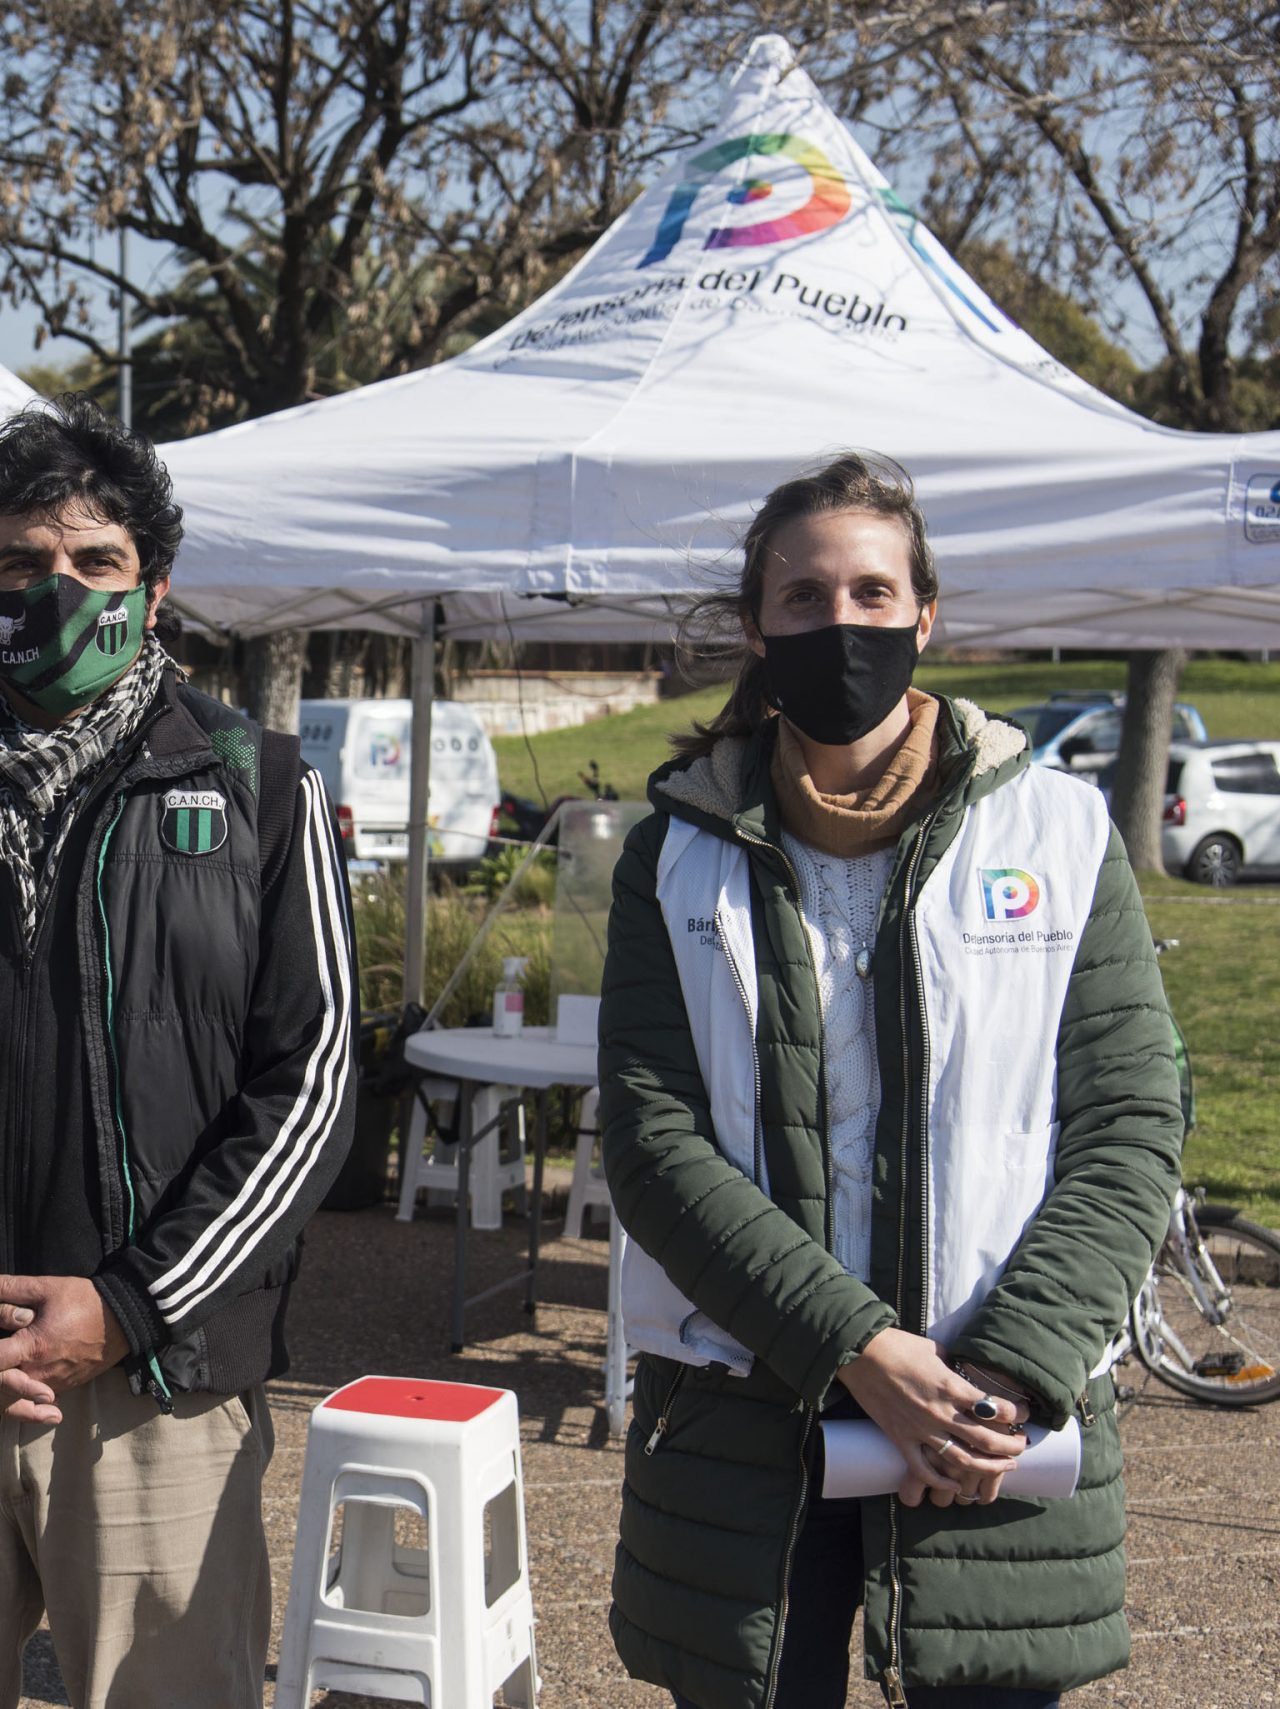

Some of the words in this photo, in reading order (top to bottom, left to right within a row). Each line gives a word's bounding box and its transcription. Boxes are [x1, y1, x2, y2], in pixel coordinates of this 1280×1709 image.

[698, 269, 762, 292] del
[1017, 930, 1035, 942] del
[1036, 929, 1073, 942] Pueblo
